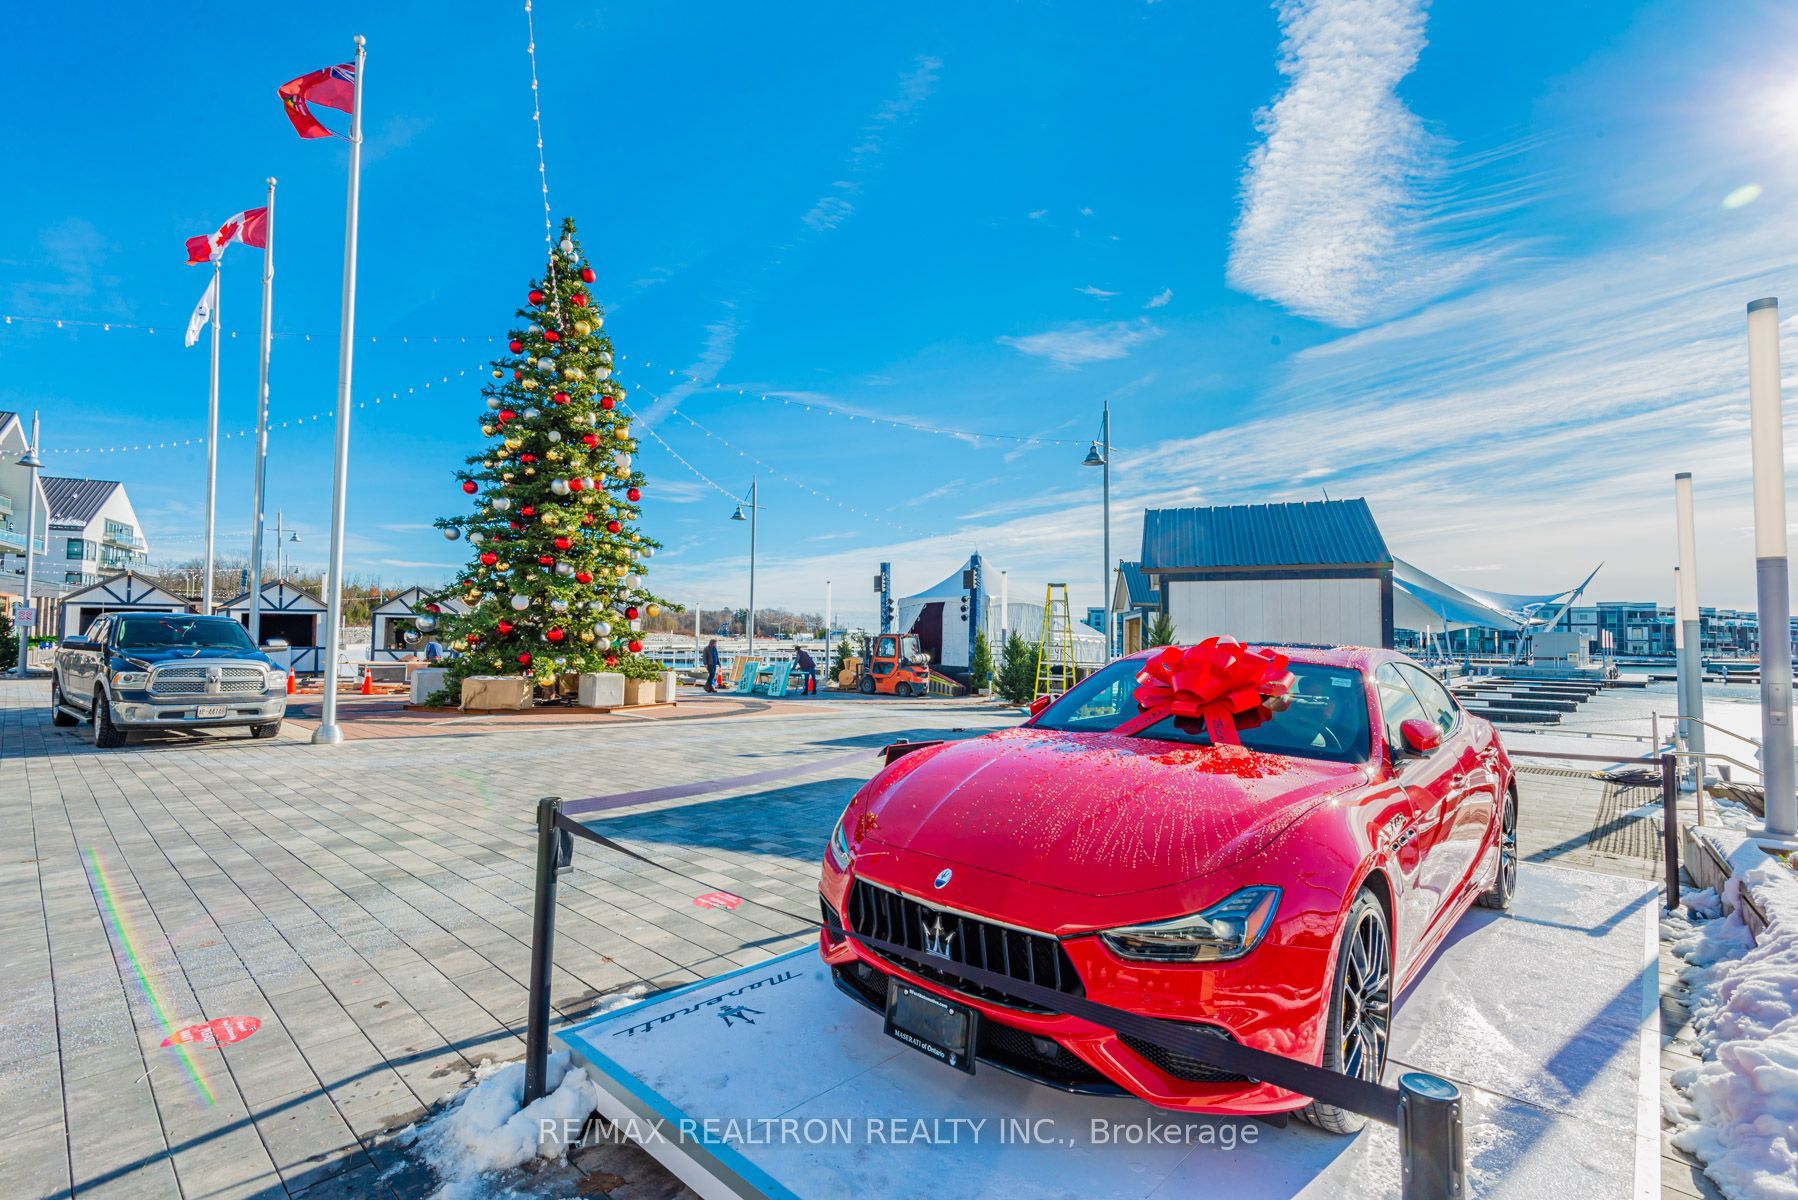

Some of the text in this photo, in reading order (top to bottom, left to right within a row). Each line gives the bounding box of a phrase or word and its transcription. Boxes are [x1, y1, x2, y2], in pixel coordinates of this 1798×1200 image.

[612, 971, 803, 1037] Maserati
[894, 1029, 921, 1047] MASERATI
[927, 1045, 945, 1058] Ontario
